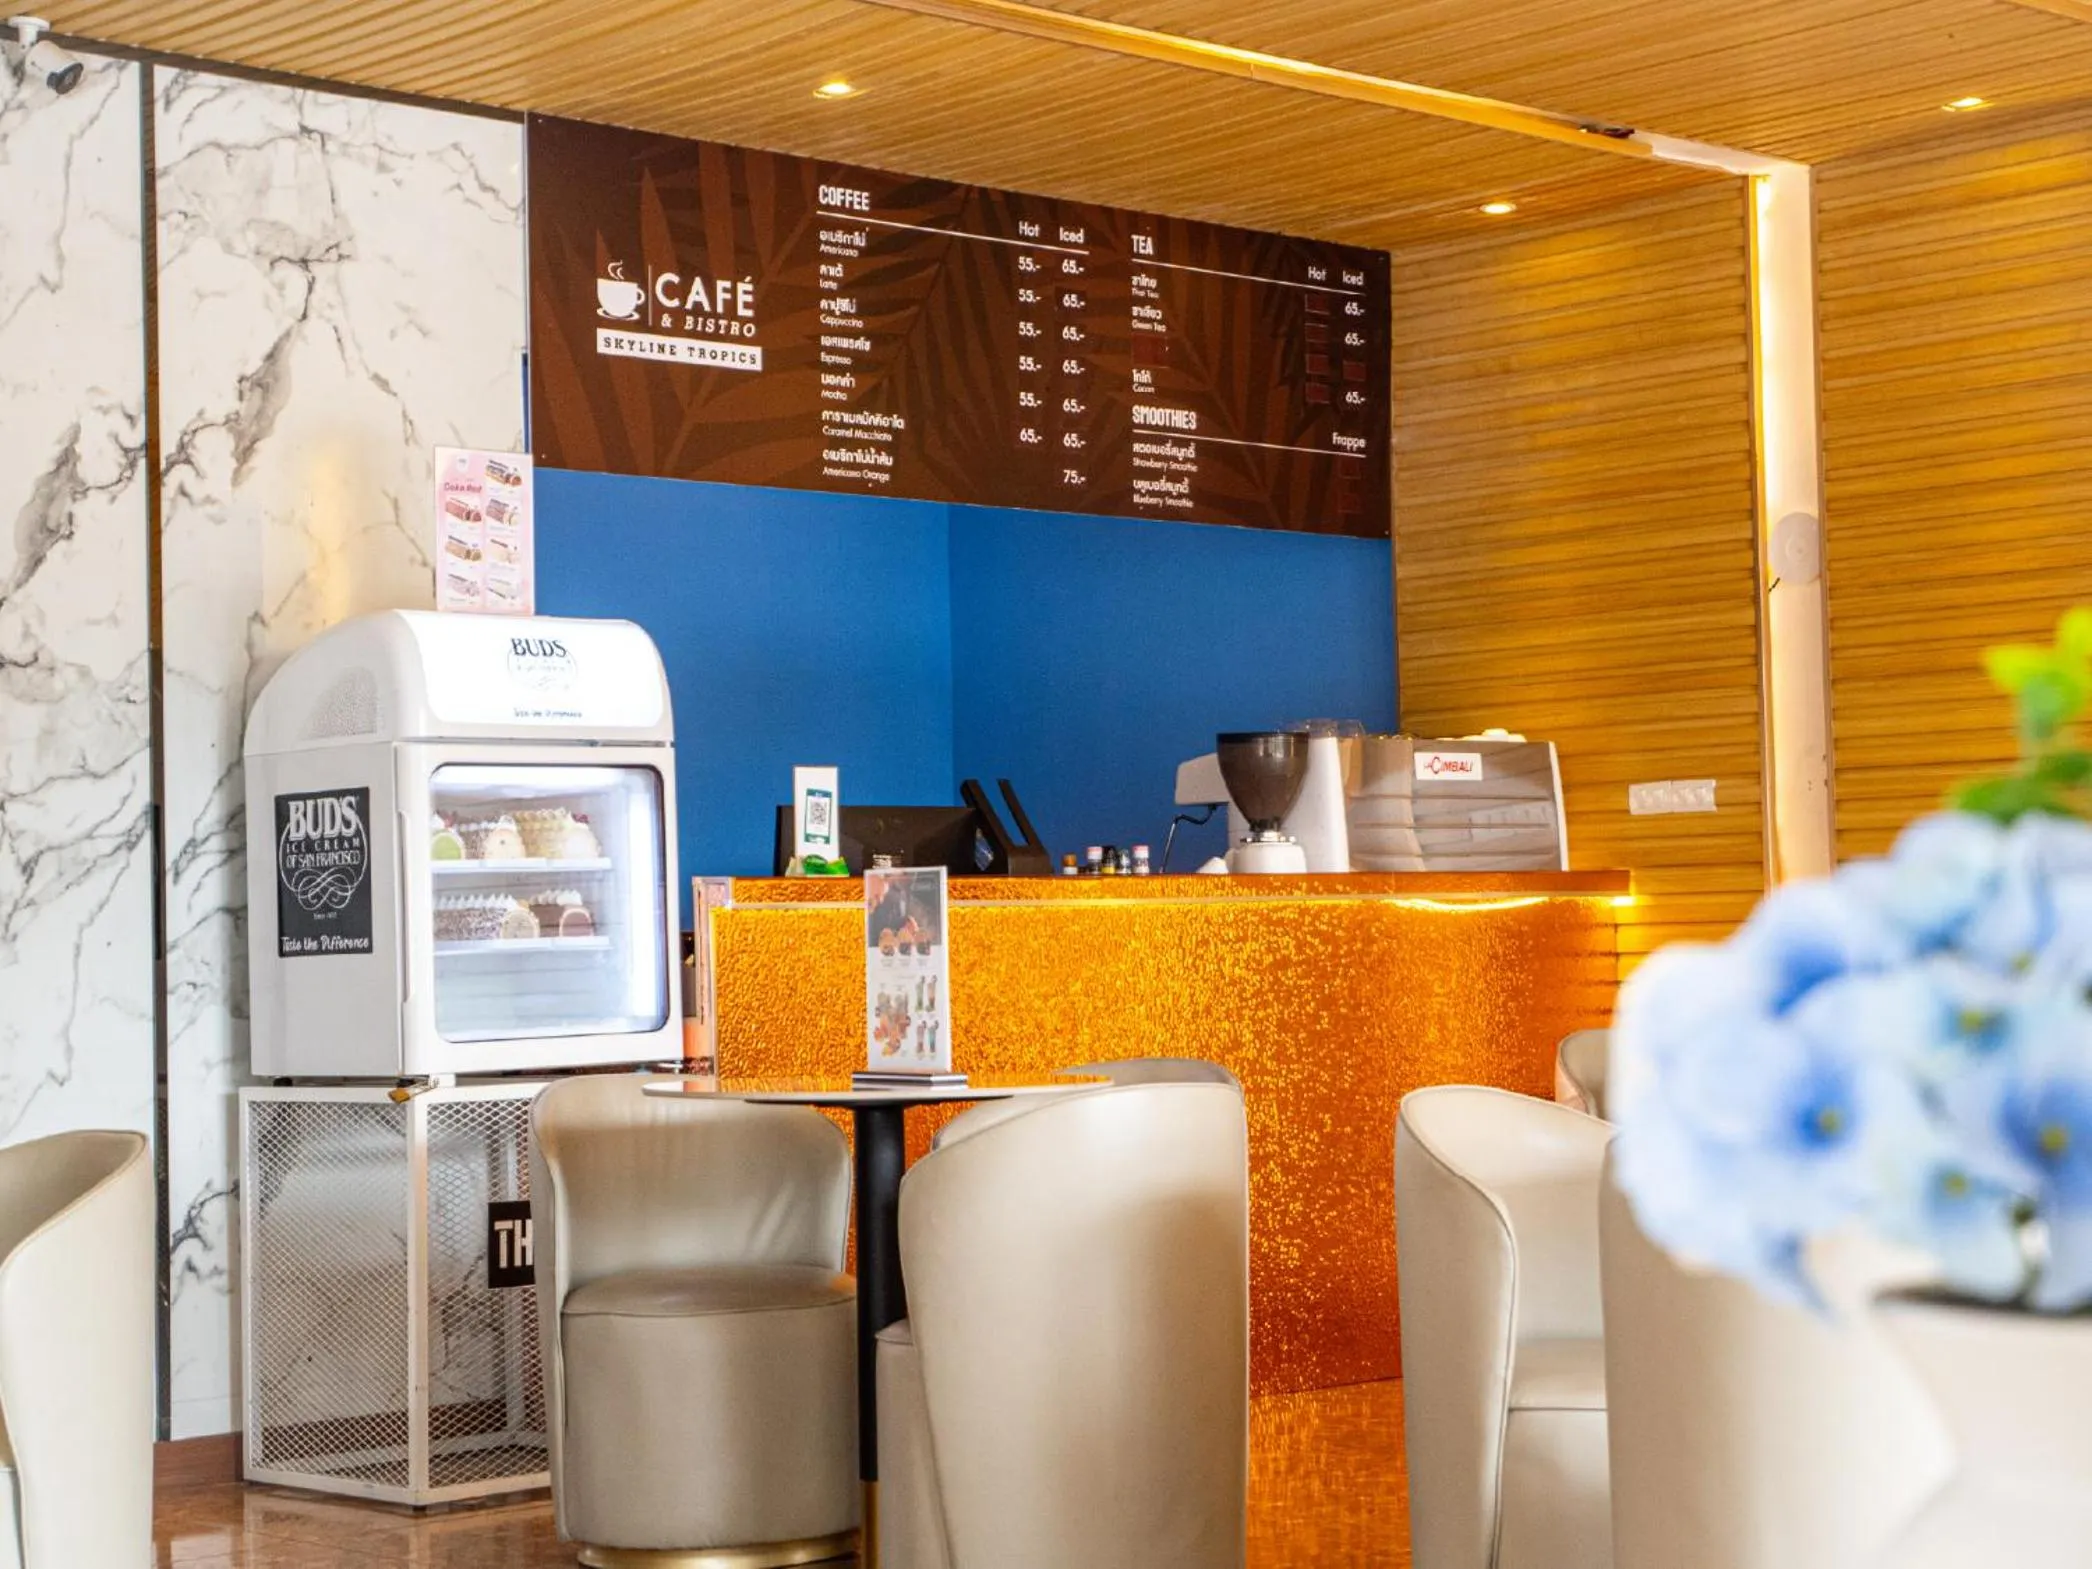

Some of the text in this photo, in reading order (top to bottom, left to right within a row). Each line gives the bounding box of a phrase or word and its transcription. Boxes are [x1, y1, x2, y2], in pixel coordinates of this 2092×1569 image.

[819, 185, 870, 211] COFFEE
[1019, 221, 1085, 244] Hot Iced
[819, 244, 860, 258] Americano
[1131, 235, 1154, 255] TEA
[1308, 265, 1365, 286] Hot Iced
[655, 271, 755, 318] CAFÉ
[661, 313, 757, 338] & BISTRO
[819, 313, 864, 329] Cappuccino
[603, 336, 758, 365] SKYLINE TROPICS
[820, 389, 848, 401] Mocha
[1132, 404, 1197, 430] SMOOTHIES
[822, 425, 853, 438] Caramel
[1332, 431, 1366, 451] Frappe
[314, 837, 361, 851] CREAM
